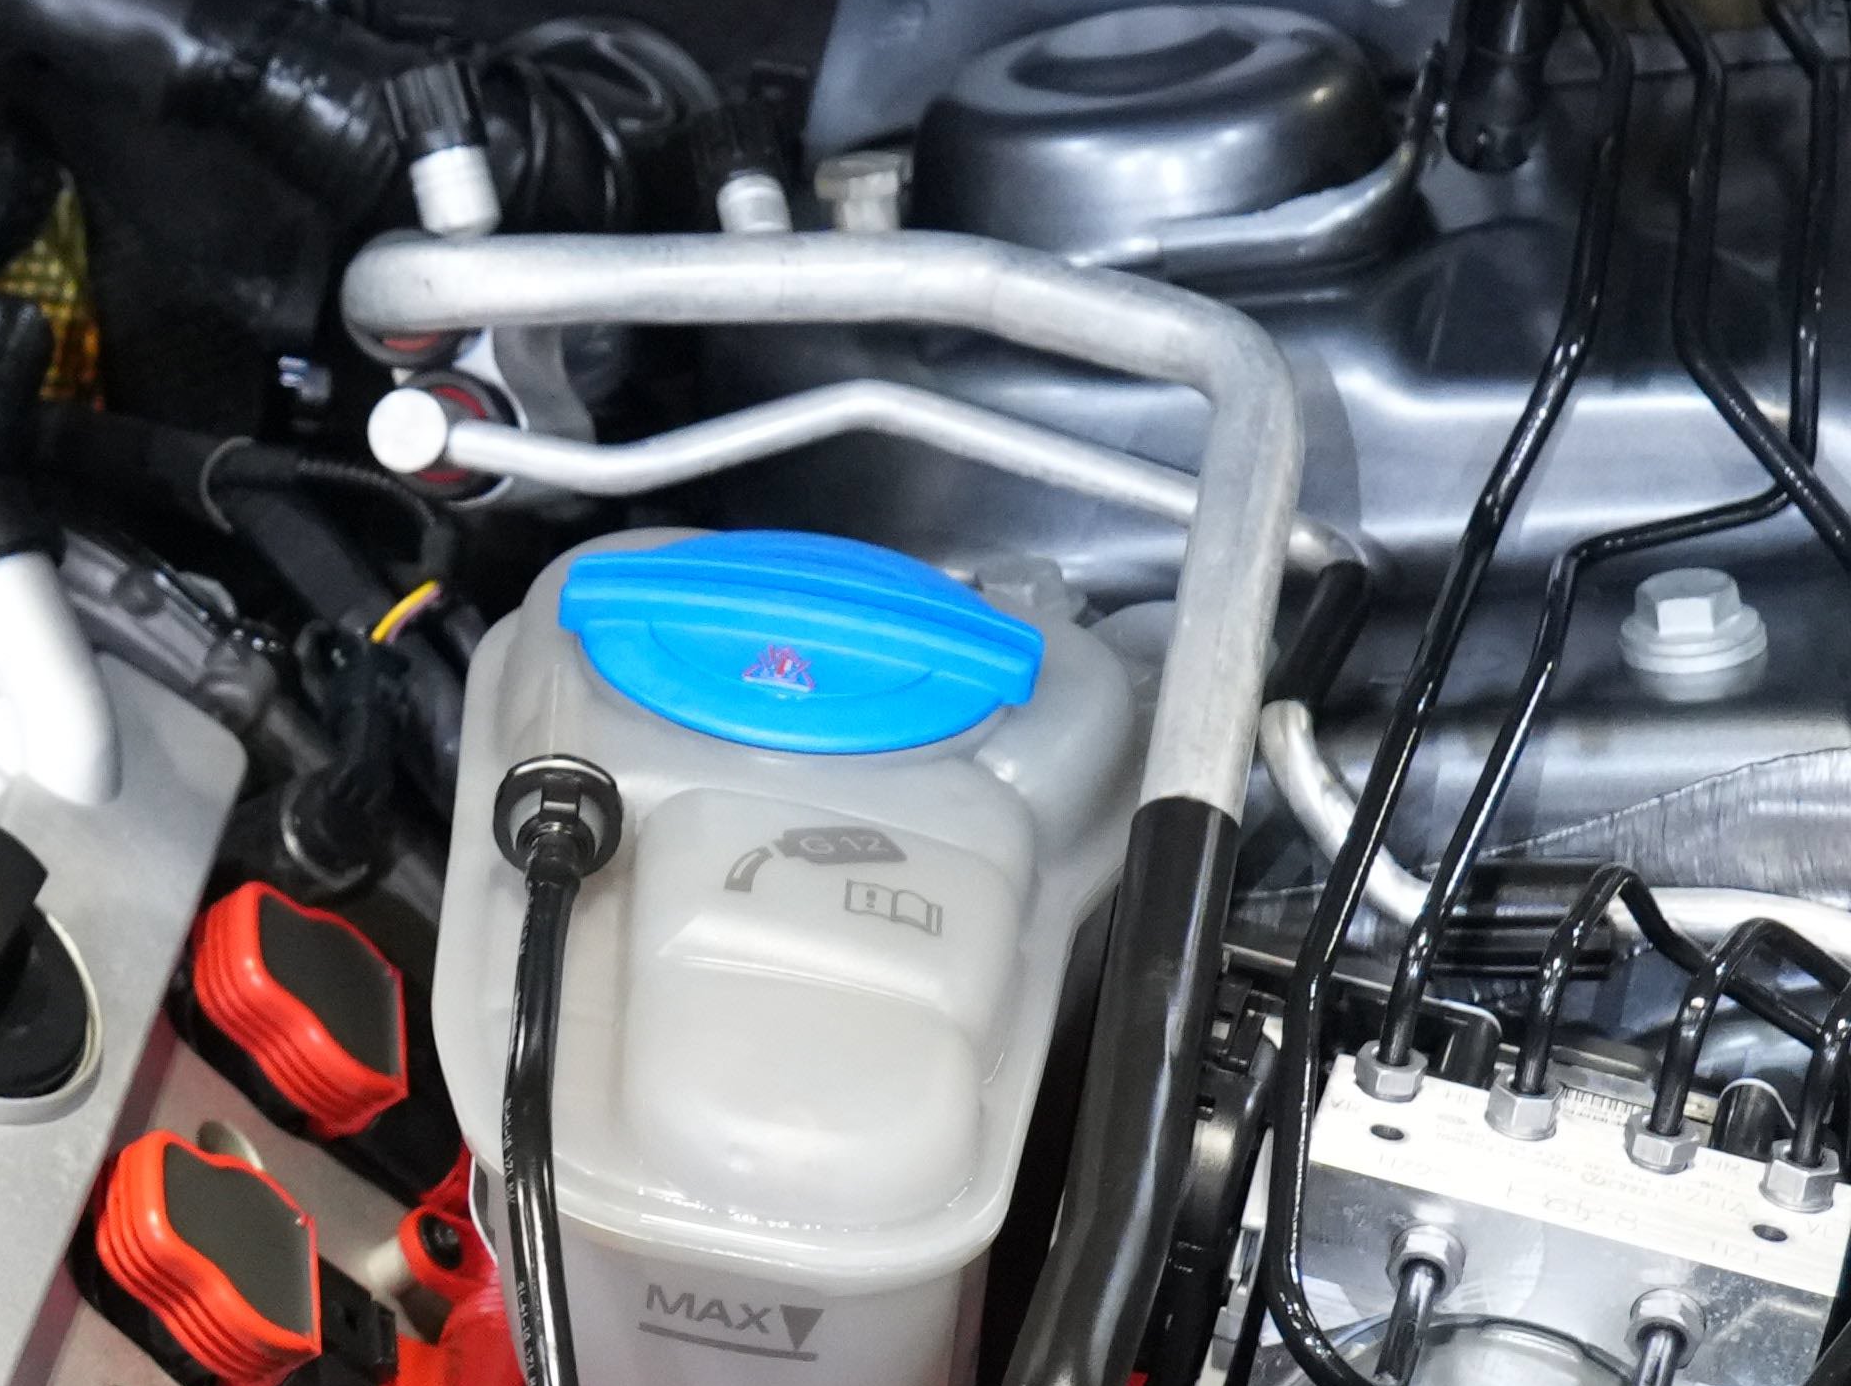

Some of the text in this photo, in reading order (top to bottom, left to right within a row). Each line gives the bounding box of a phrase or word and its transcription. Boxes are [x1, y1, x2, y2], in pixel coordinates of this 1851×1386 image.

[799, 835, 891, 856] G 12
[646, 1283, 772, 1334] MAX
